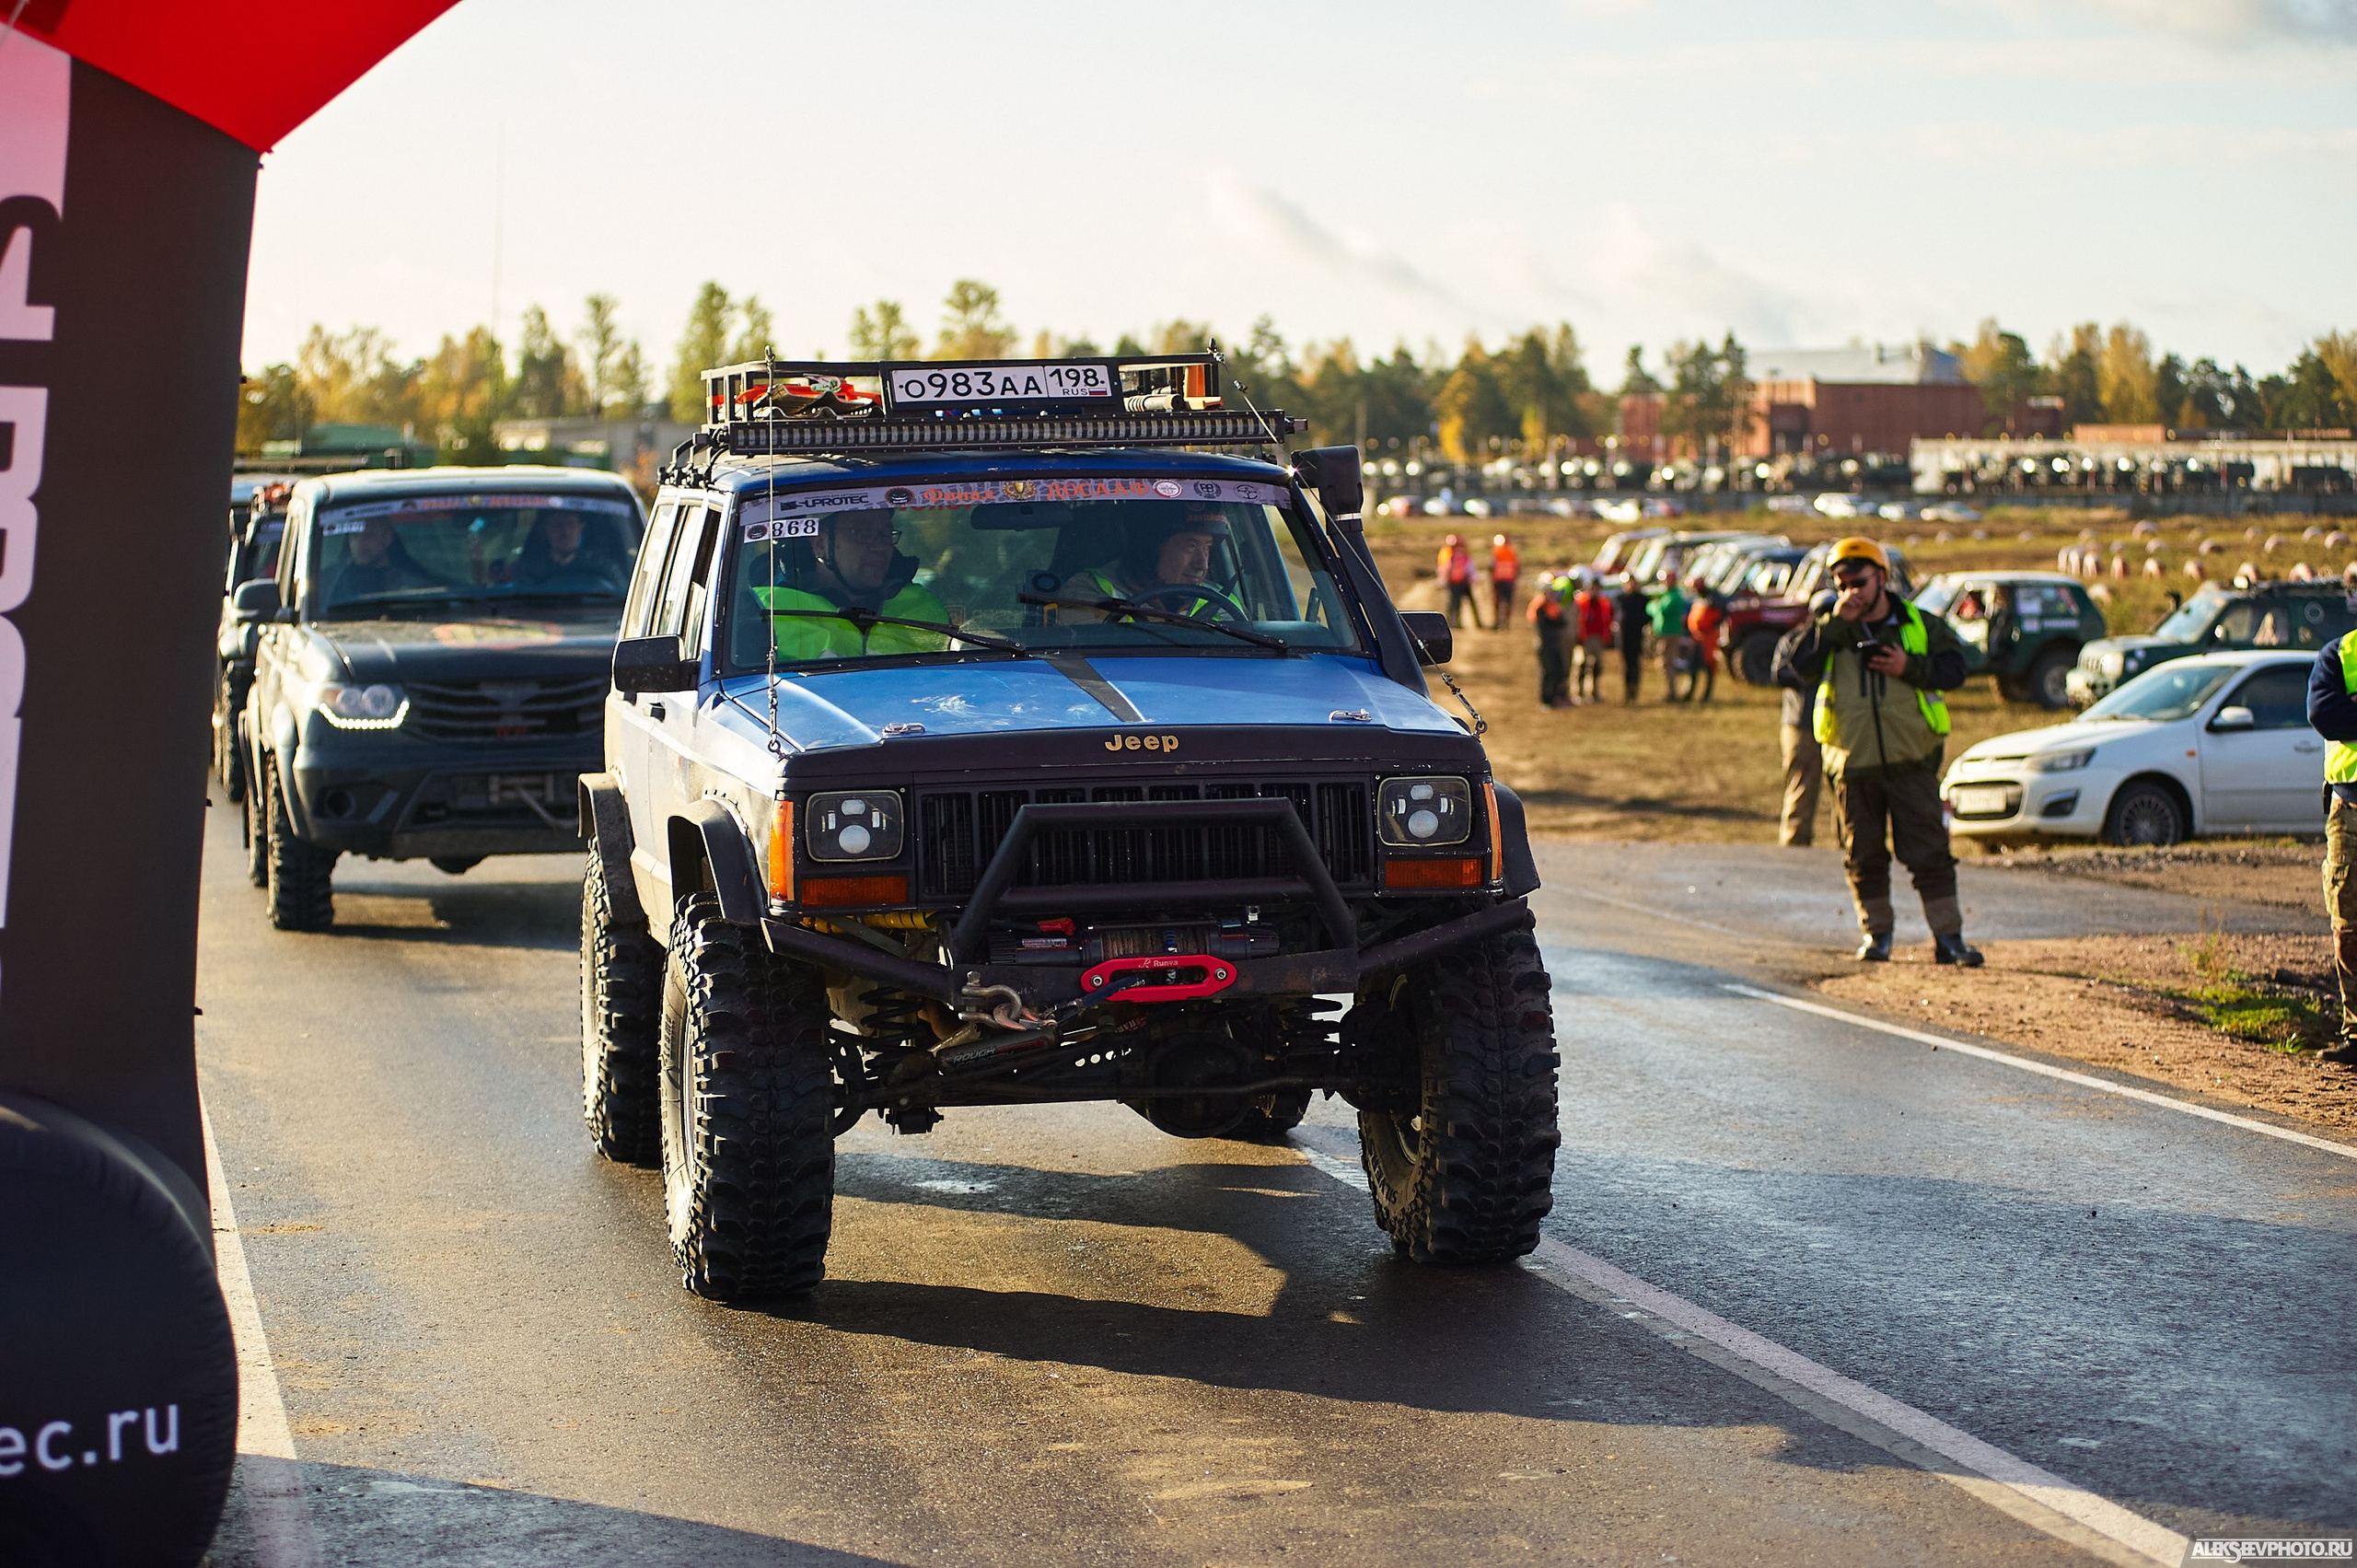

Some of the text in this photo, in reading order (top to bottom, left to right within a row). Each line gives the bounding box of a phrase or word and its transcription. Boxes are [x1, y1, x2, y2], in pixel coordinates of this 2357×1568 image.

[1049, 368, 1099, 388] 198
[1062, 388, 1088, 396] RUS
[923, 482, 1149, 503] Финал ДОСААФ
[795, 495, 868, 508] SUPROTEC
[772, 519, 816, 536] 868
[1105, 734, 1178, 752] Jeep
[952, 1047, 996, 1063] ROUGH
